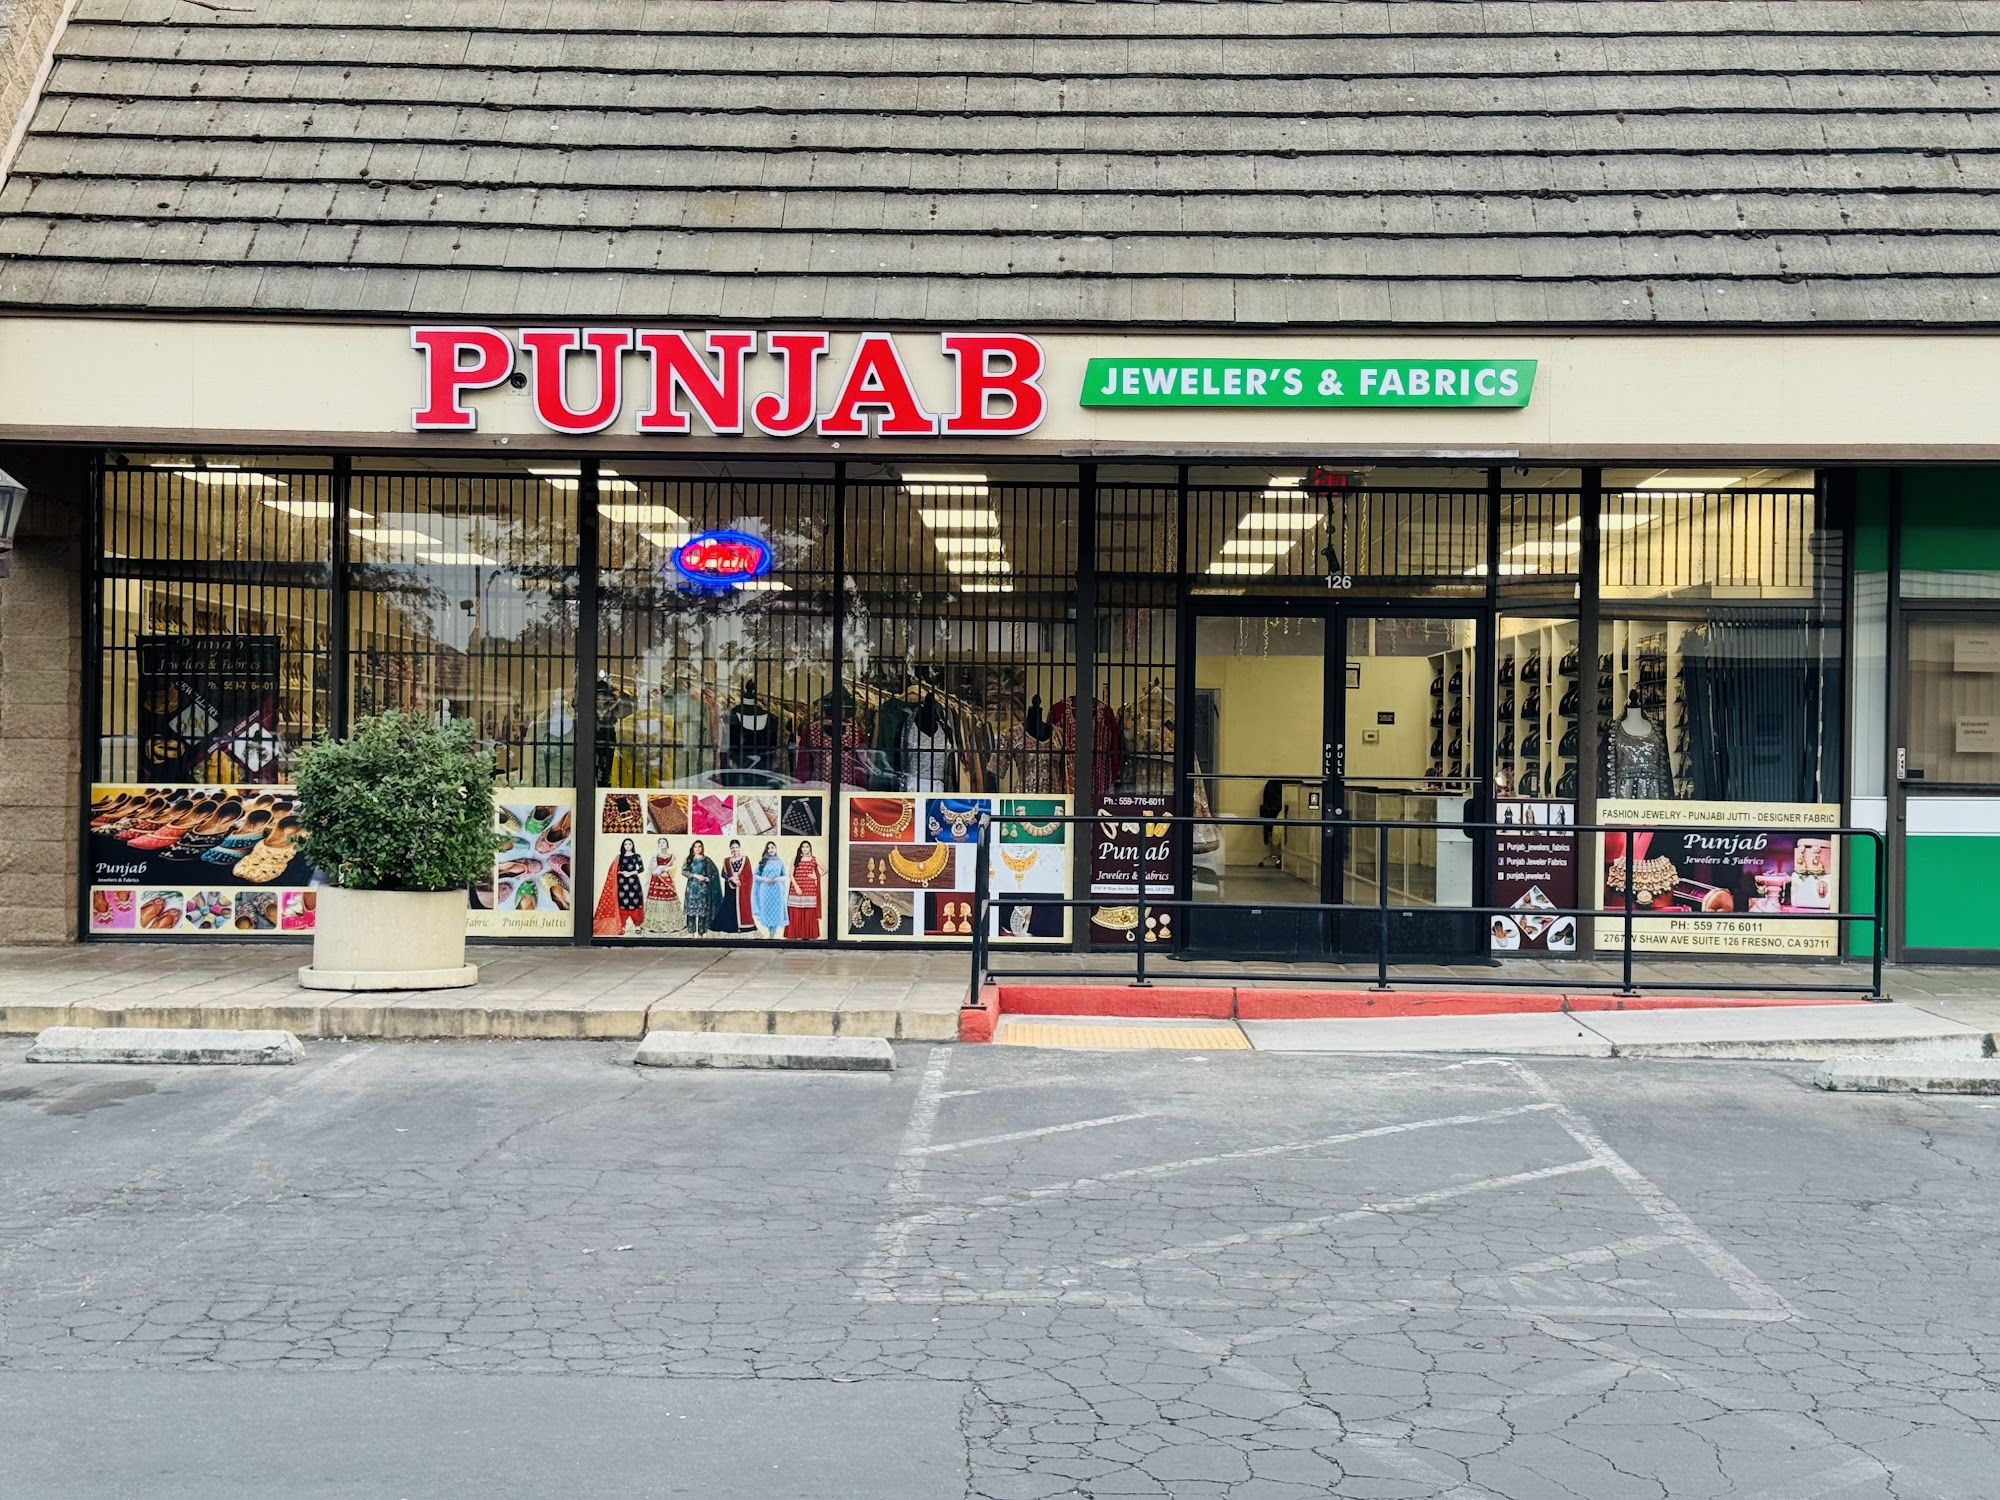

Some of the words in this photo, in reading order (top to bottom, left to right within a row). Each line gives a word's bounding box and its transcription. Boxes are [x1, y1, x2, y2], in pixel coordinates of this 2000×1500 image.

[410, 326, 1048, 437] PUNJAB
[1100, 367, 1303, 396] JEWELER'S
[1317, 368, 1344, 396] &
[1359, 368, 1519, 396] FABRICS
[1325, 575, 1352, 589] 126
[208, 659, 217, 670] &
[1119, 796, 1165, 806] 559-776-6011
[1602, 808, 1639, 819] FASHION
[1641, 809, 1681, 820] JEWELRY
[1688, 811, 1725, 820] PUNJABI
[1727, 812, 1750, 821] JUTTI
[1757, 812, 1801, 822] DESIGNER
[1804, 814, 1834, 823] FABRIC
[1683, 833, 1768, 855] Punjab
[1098, 840, 1170, 867] Punab
[1683, 855, 1720, 864] Jewelers
[1722, 857, 1730, 865] &
[1731, 856, 1764, 866] Fabrics
[96, 861, 147, 877] Punjab
[1506, 857, 1526, 867] Punjab
[1547, 858, 1568, 867] Fabrics
[1096, 869, 1130, 880] Jewelers
[1131, 870, 1139, 880] &
[1144, 870, 1169, 880] abrics
[502, 917, 538, 929] Punjabi
[541, 918, 567, 928] Juttis
[1670, 920, 1690, 931] PH:
[1693, 921, 1713, 931] 559
[1716, 921, 1735, 931] 776
[1738, 922, 1763, 932] 6011
[1604, 933, 1626, 943] 2767
[1639, 934, 1668, 944] SHAW
[1670, 935, 1689, 944] AVE
[1692, 936, 1720, 945] SUITE
[1724, 937, 1739, 946] 126
[1741, 937, 1785, 948] FRESNO,
[1787, 938, 1801, 947] CA
[1803, 939, 1830, 948] 93711
